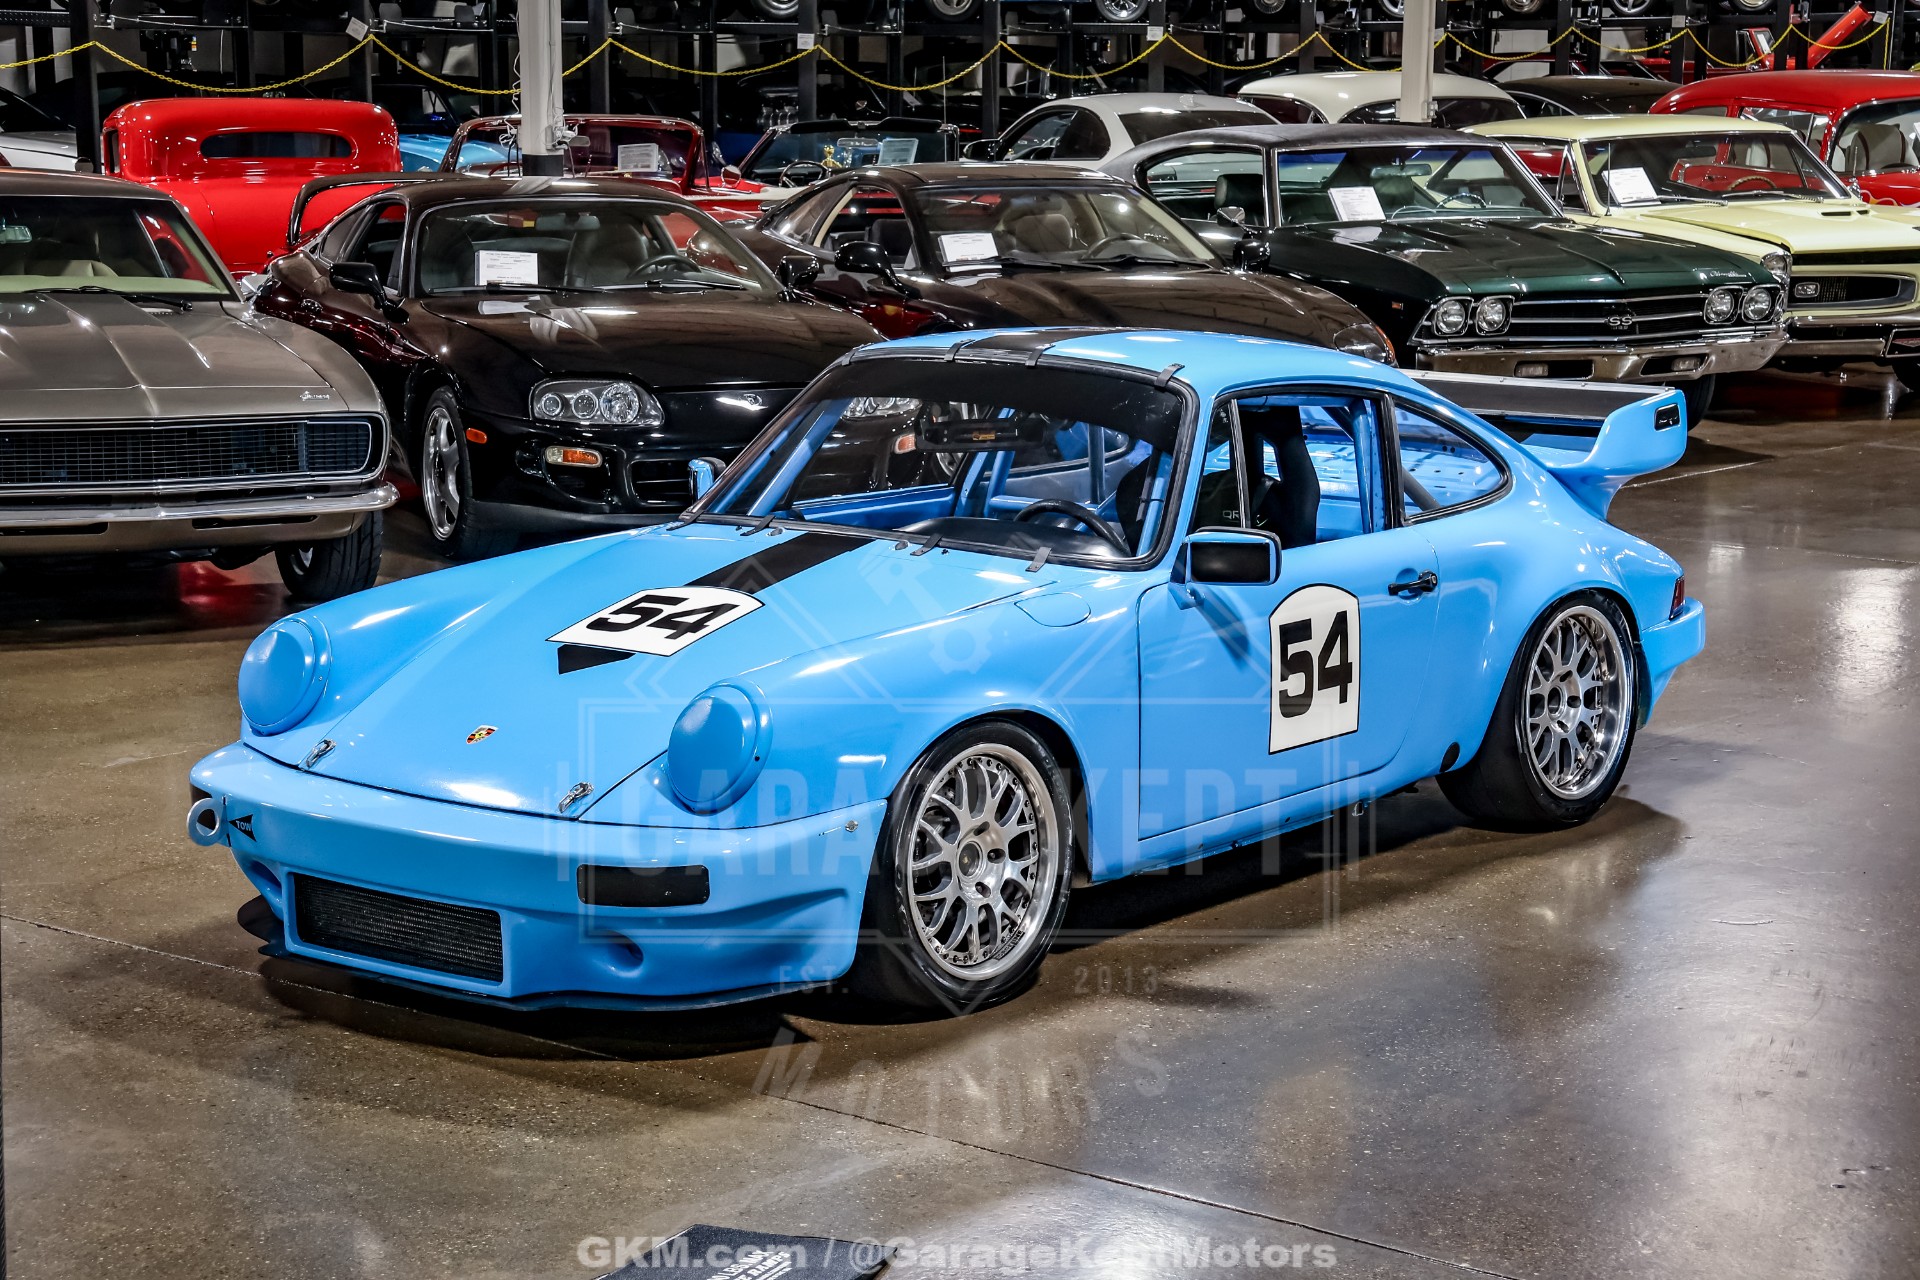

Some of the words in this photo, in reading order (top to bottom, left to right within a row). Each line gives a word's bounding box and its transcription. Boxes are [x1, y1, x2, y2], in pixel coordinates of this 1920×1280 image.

[1609, 316, 1632, 326] SS
[586, 594, 740, 640] 54
[1278, 610, 1353, 719] 54
[235, 820, 253, 832] TOW
